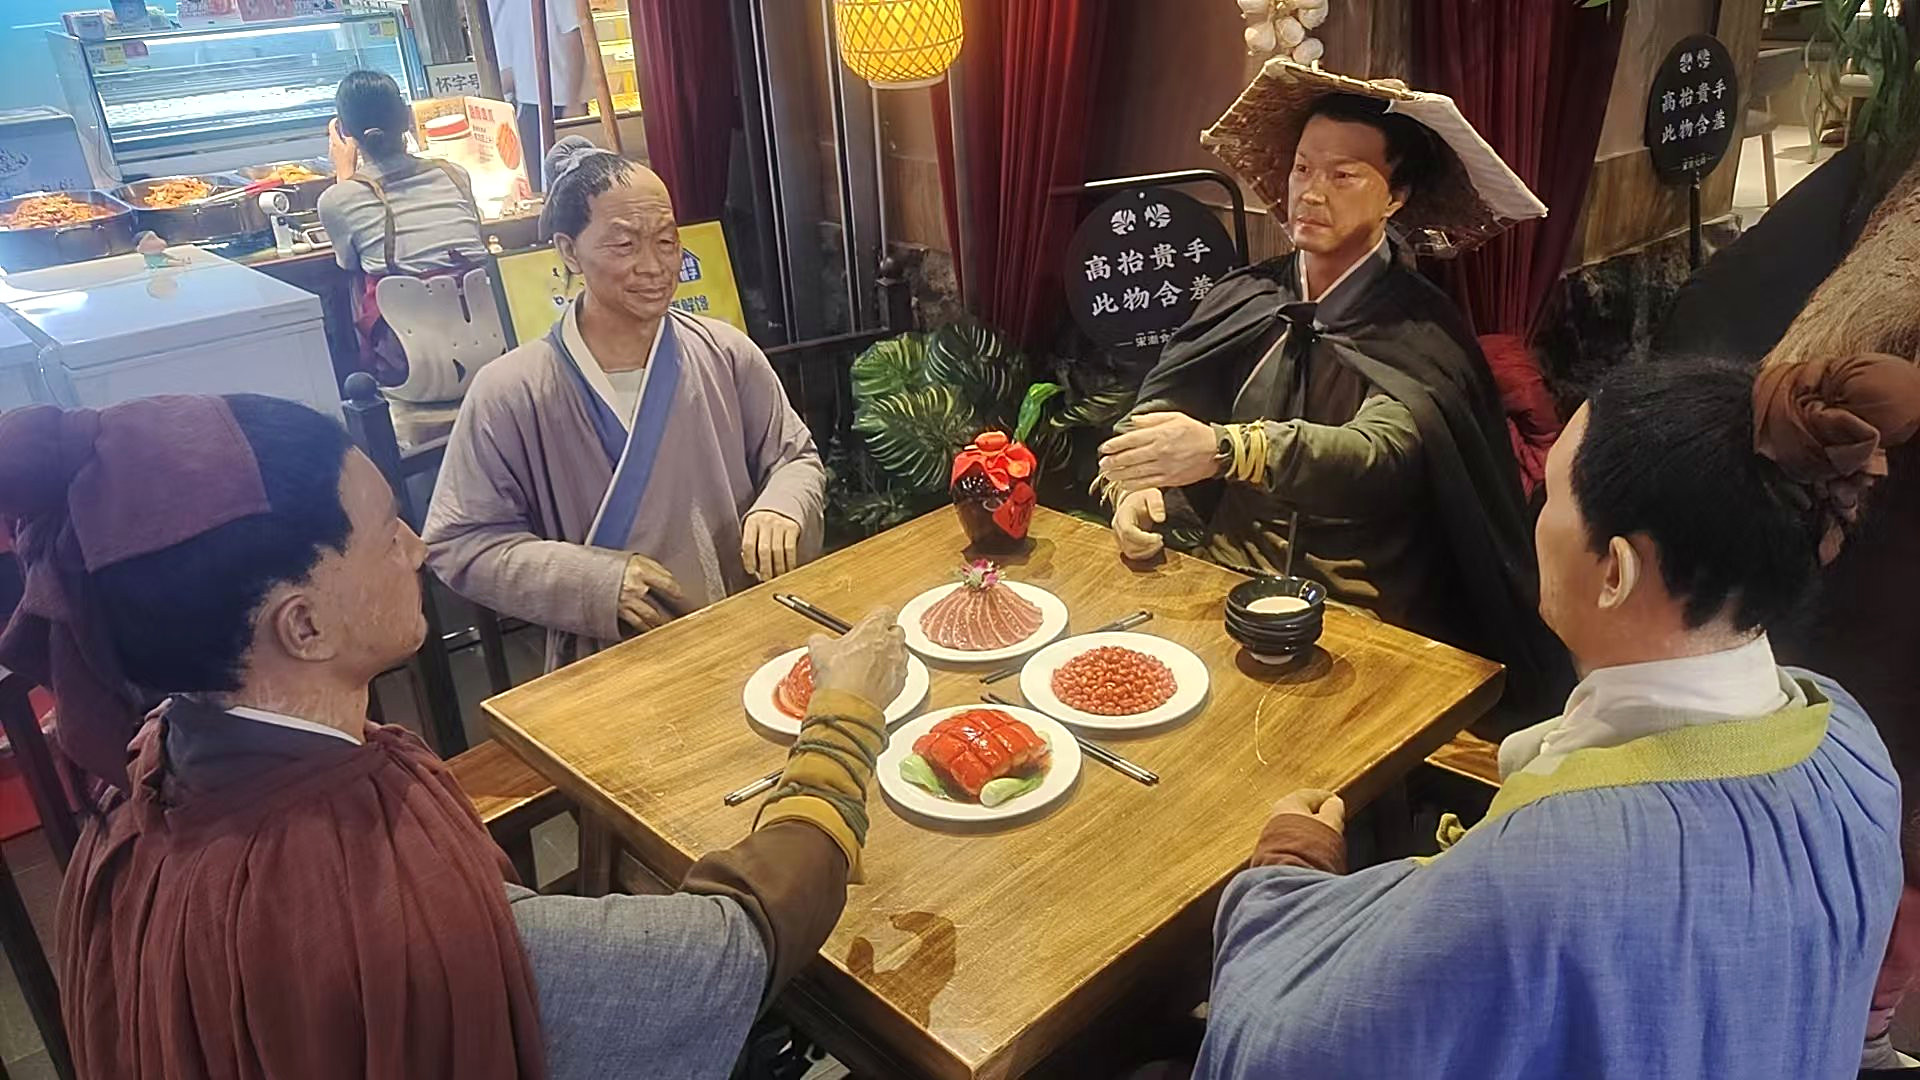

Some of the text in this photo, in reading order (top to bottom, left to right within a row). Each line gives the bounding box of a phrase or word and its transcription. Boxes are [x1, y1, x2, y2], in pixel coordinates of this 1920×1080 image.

[1084, 237, 1211, 281] 高抬贵手
[1091, 273, 1214, 316] 此物含羞
